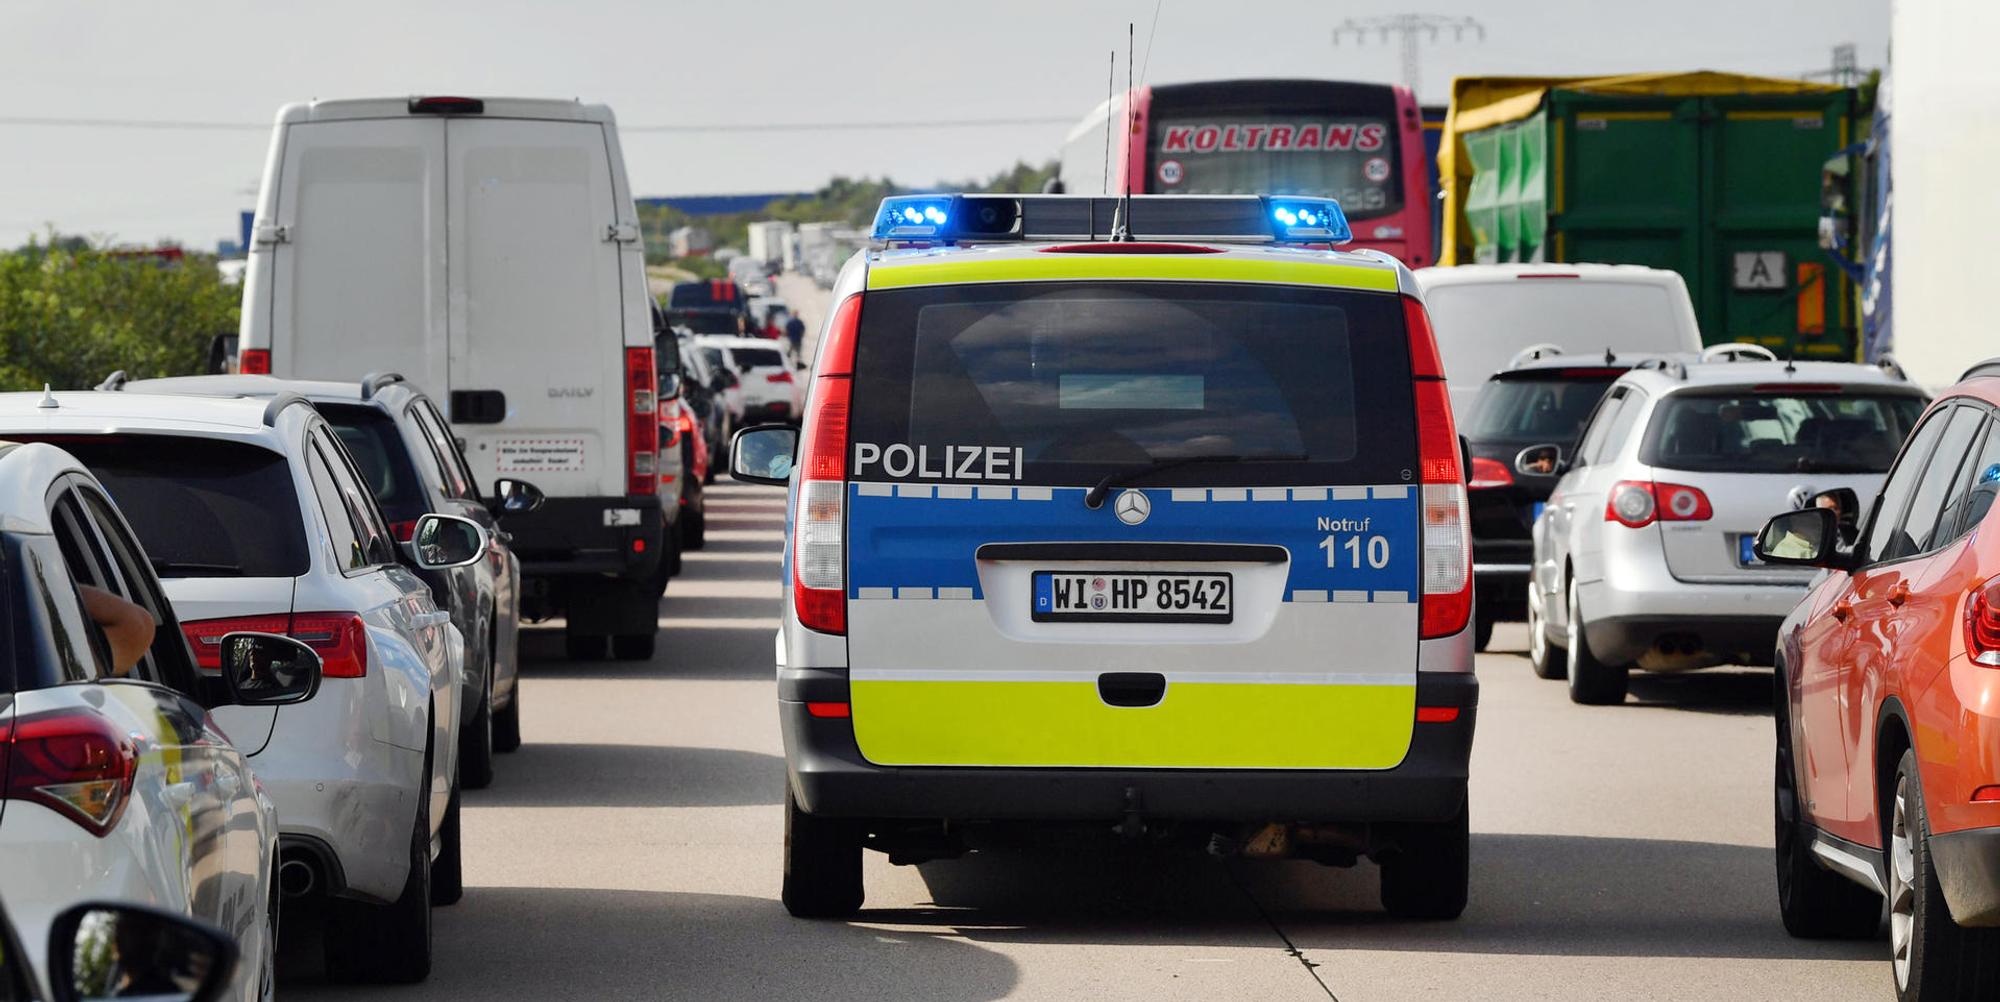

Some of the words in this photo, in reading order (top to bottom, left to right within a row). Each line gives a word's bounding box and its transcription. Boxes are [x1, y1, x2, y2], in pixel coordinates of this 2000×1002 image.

[1163, 124, 1386, 153] KOLTRANS
[1749, 253, 1772, 282] A
[853, 442, 1024, 481] POLIZEI
[1317, 516, 1371, 532] Notruf
[1319, 535, 1389, 569] 110
[1054, 578, 1088, 609] WI
[1111, 578, 1148, 609] HP
[1156, 579, 1226, 610] 8542
